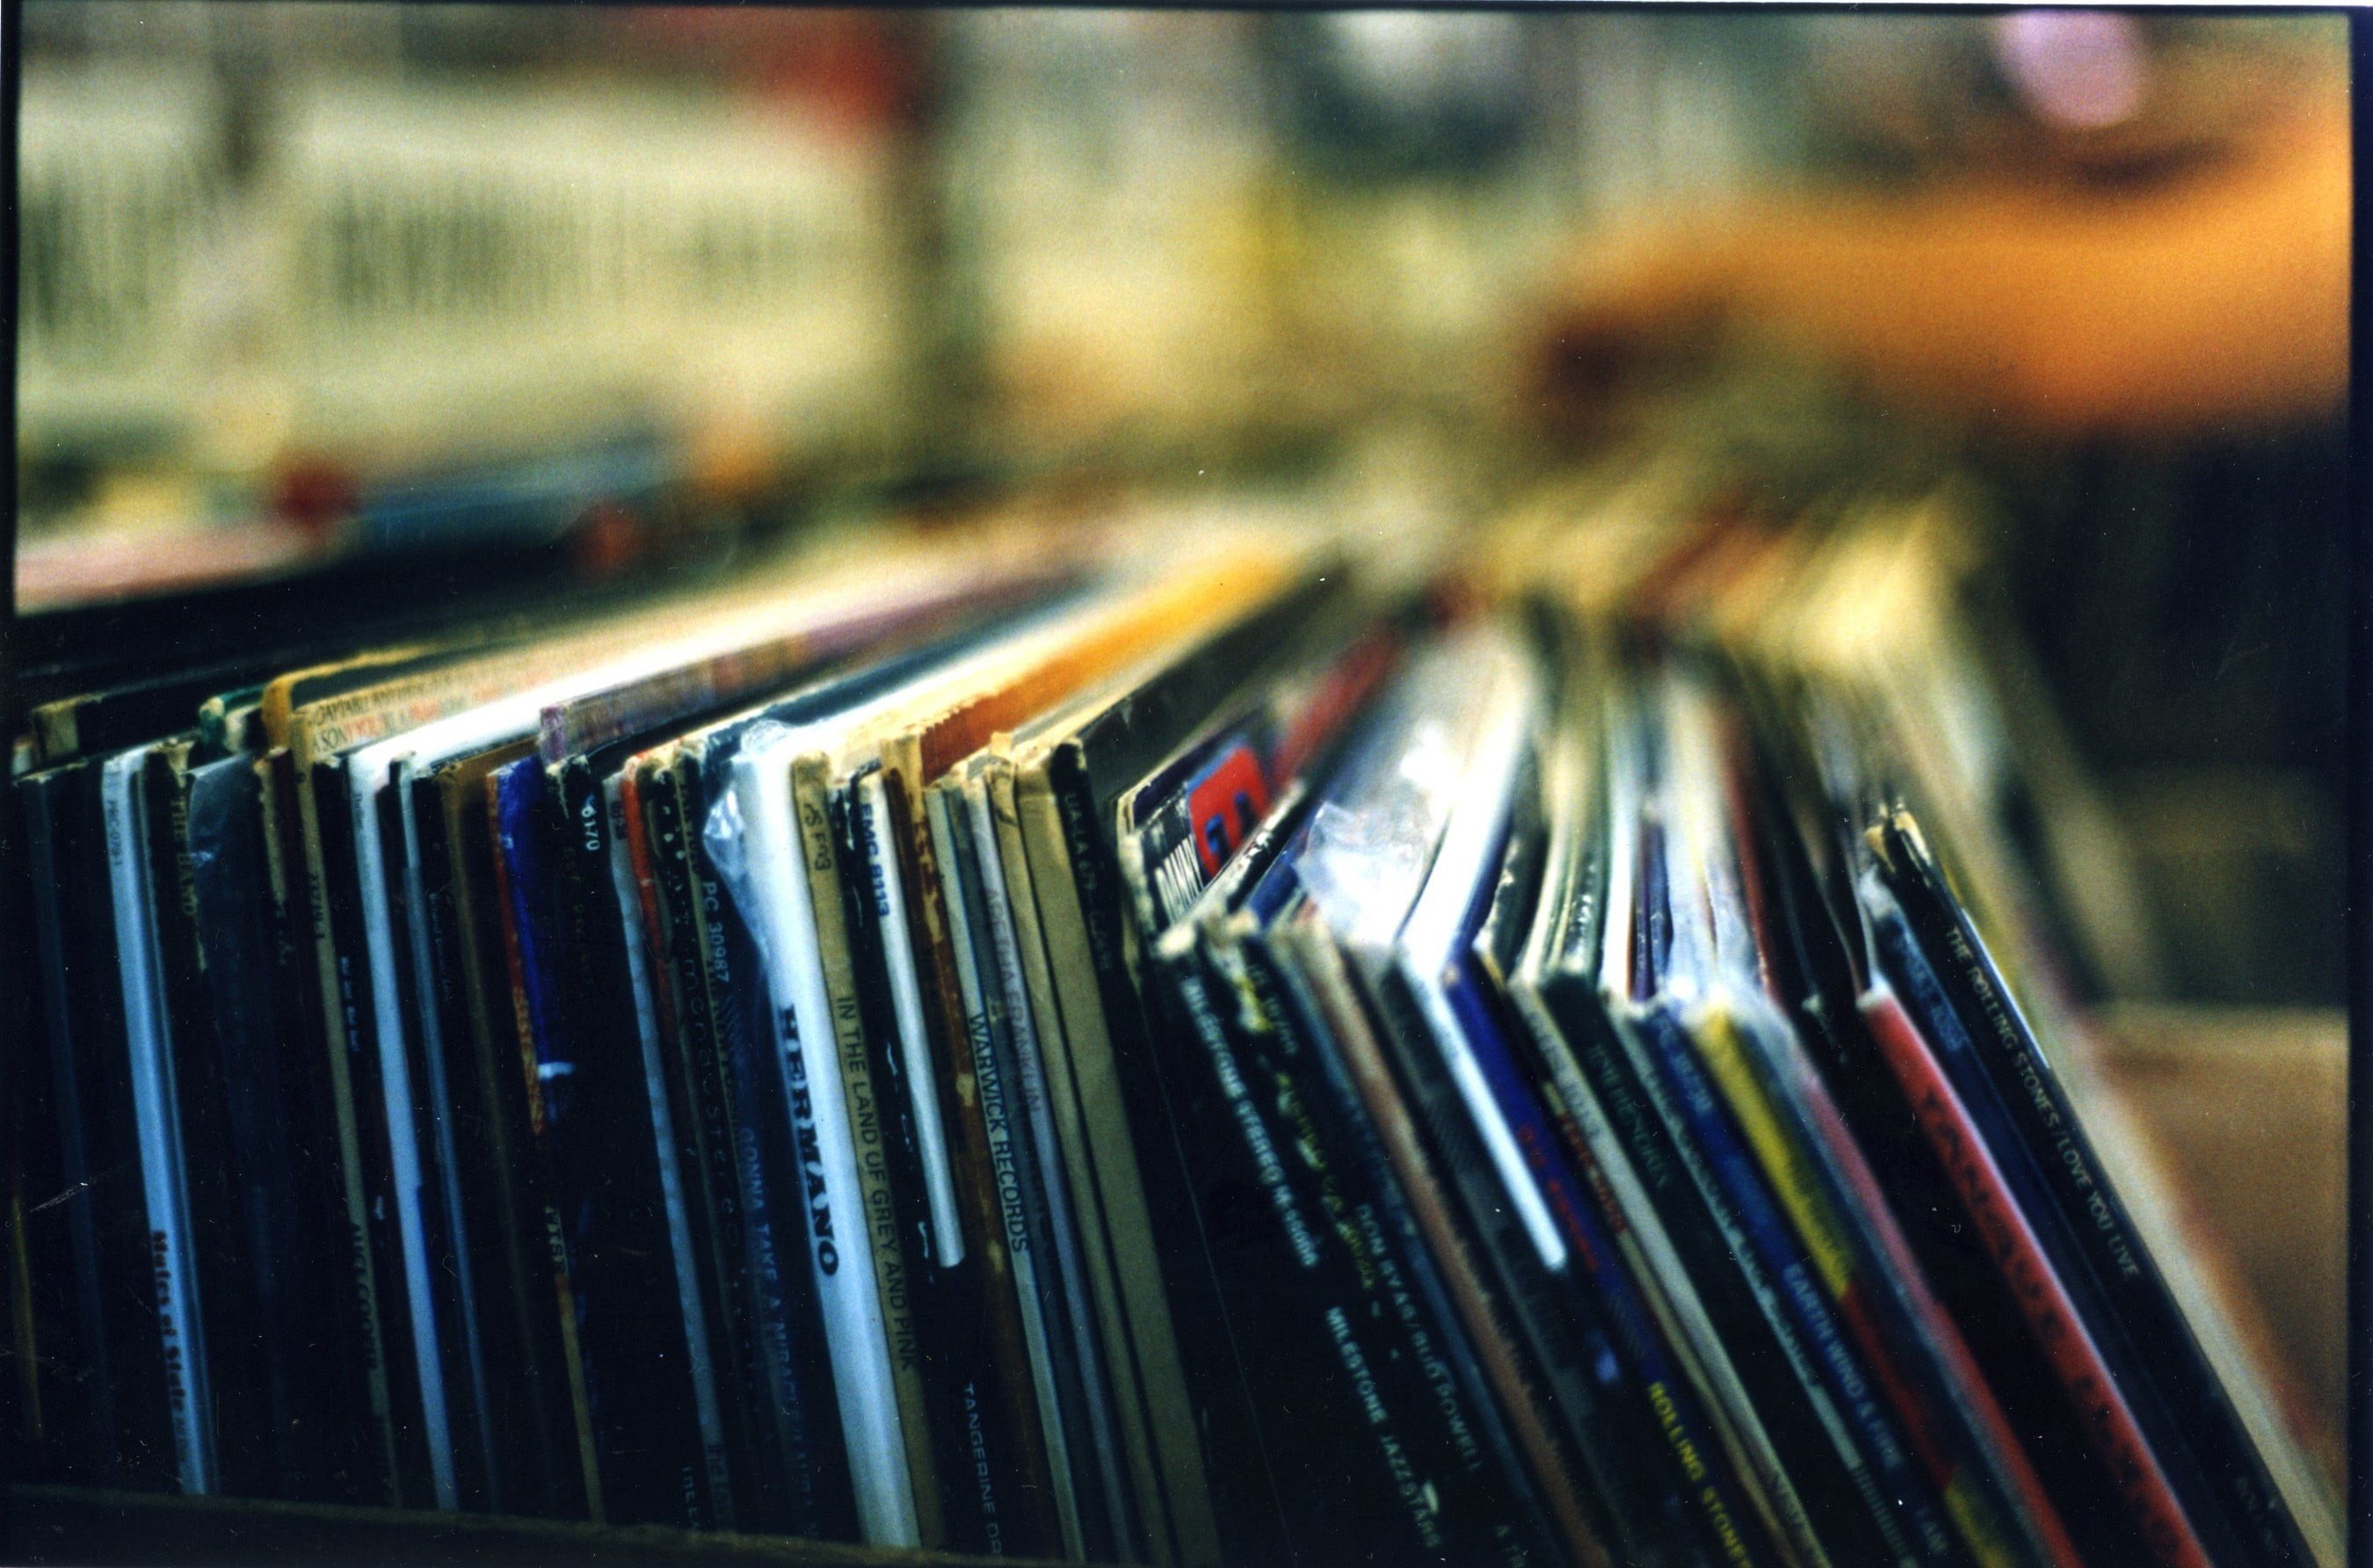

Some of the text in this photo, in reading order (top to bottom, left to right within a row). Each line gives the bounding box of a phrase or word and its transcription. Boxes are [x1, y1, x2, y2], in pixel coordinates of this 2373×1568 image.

[863, 802, 891, 918] EMC 8113
[704, 882, 720, 911] PC
[710, 923, 729, 983] 30987
[836, 996, 855, 1020] IN
[844, 1027, 866, 1071] THE
[853, 1083, 878, 1144] LAND
[1947, 924, 1973, 962] THE
[1965, 965, 2018, 1049] ROLLING
[2086, 1188, 2114, 1229] YOU
[2108, 1233, 2139, 1277] LIVE
[779, 1004, 839, 1277] HERMANO
[967, 1012, 1029, 1253] WARWICK RECORDS
[872, 1188, 897, 1250] GREY
[884, 1259, 906, 1310] AND
[895, 1318, 917, 1372] PINK
[1327, 1306, 1389, 1426] MILESTONE
[964, 1381, 997, 1515] TANGERINE
[1646, 1380, 1705, 1481] ROLLING
